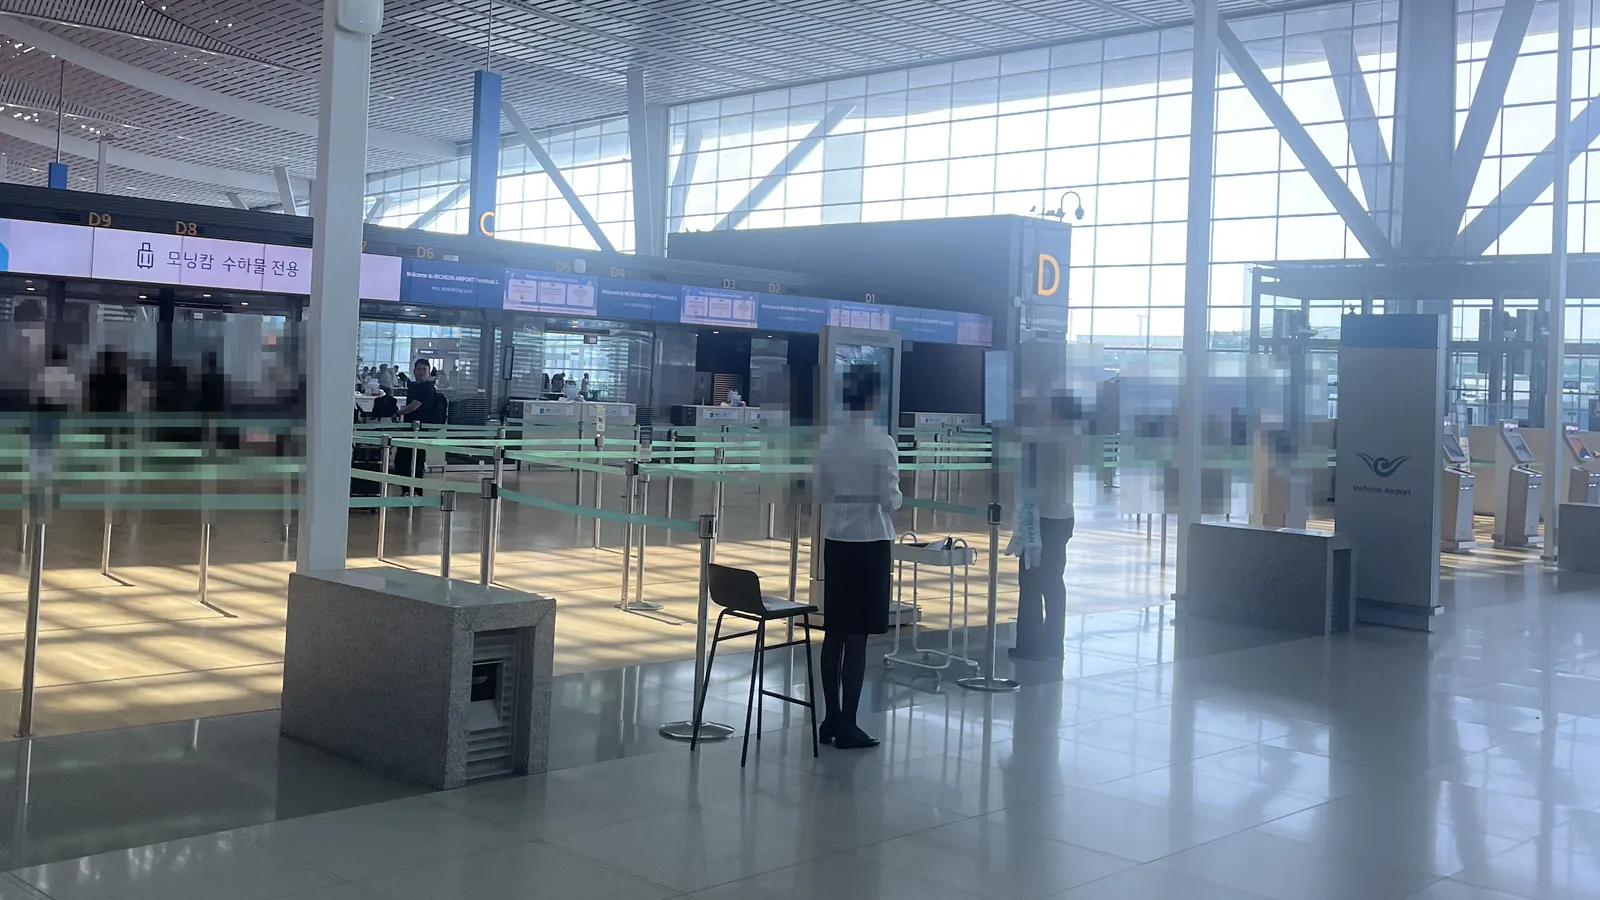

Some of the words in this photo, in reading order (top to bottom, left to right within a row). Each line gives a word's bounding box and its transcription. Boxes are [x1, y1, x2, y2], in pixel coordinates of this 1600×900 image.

[88, 212, 111, 226] D9
[480, 211, 494, 236] C
[175, 221, 196, 235] D8
[416, 246, 434, 259] D6
[167, 251, 214, 270] 모닝캄
[222, 255, 266, 275] 수하물
[271, 259, 299, 278] 전용
[556, 260, 571, 272] D5
[405, 271, 427, 279] Welcome
[434, 273, 455, 281] INCHEON
[455, 275, 475, 283] AIRPORT
[610, 266, 625, 278] D4
[1037, 253, 1059, 296] D
[723, 278, 736, 289] D3
[768, 283, 780, 294] D2
[865, 294, 875, 303] D1
[1352, 484, 1382, 493] Incheon
[1384, 486, 1411, 496] Airport
[1027, 511, 1035, 543] KOREAN
